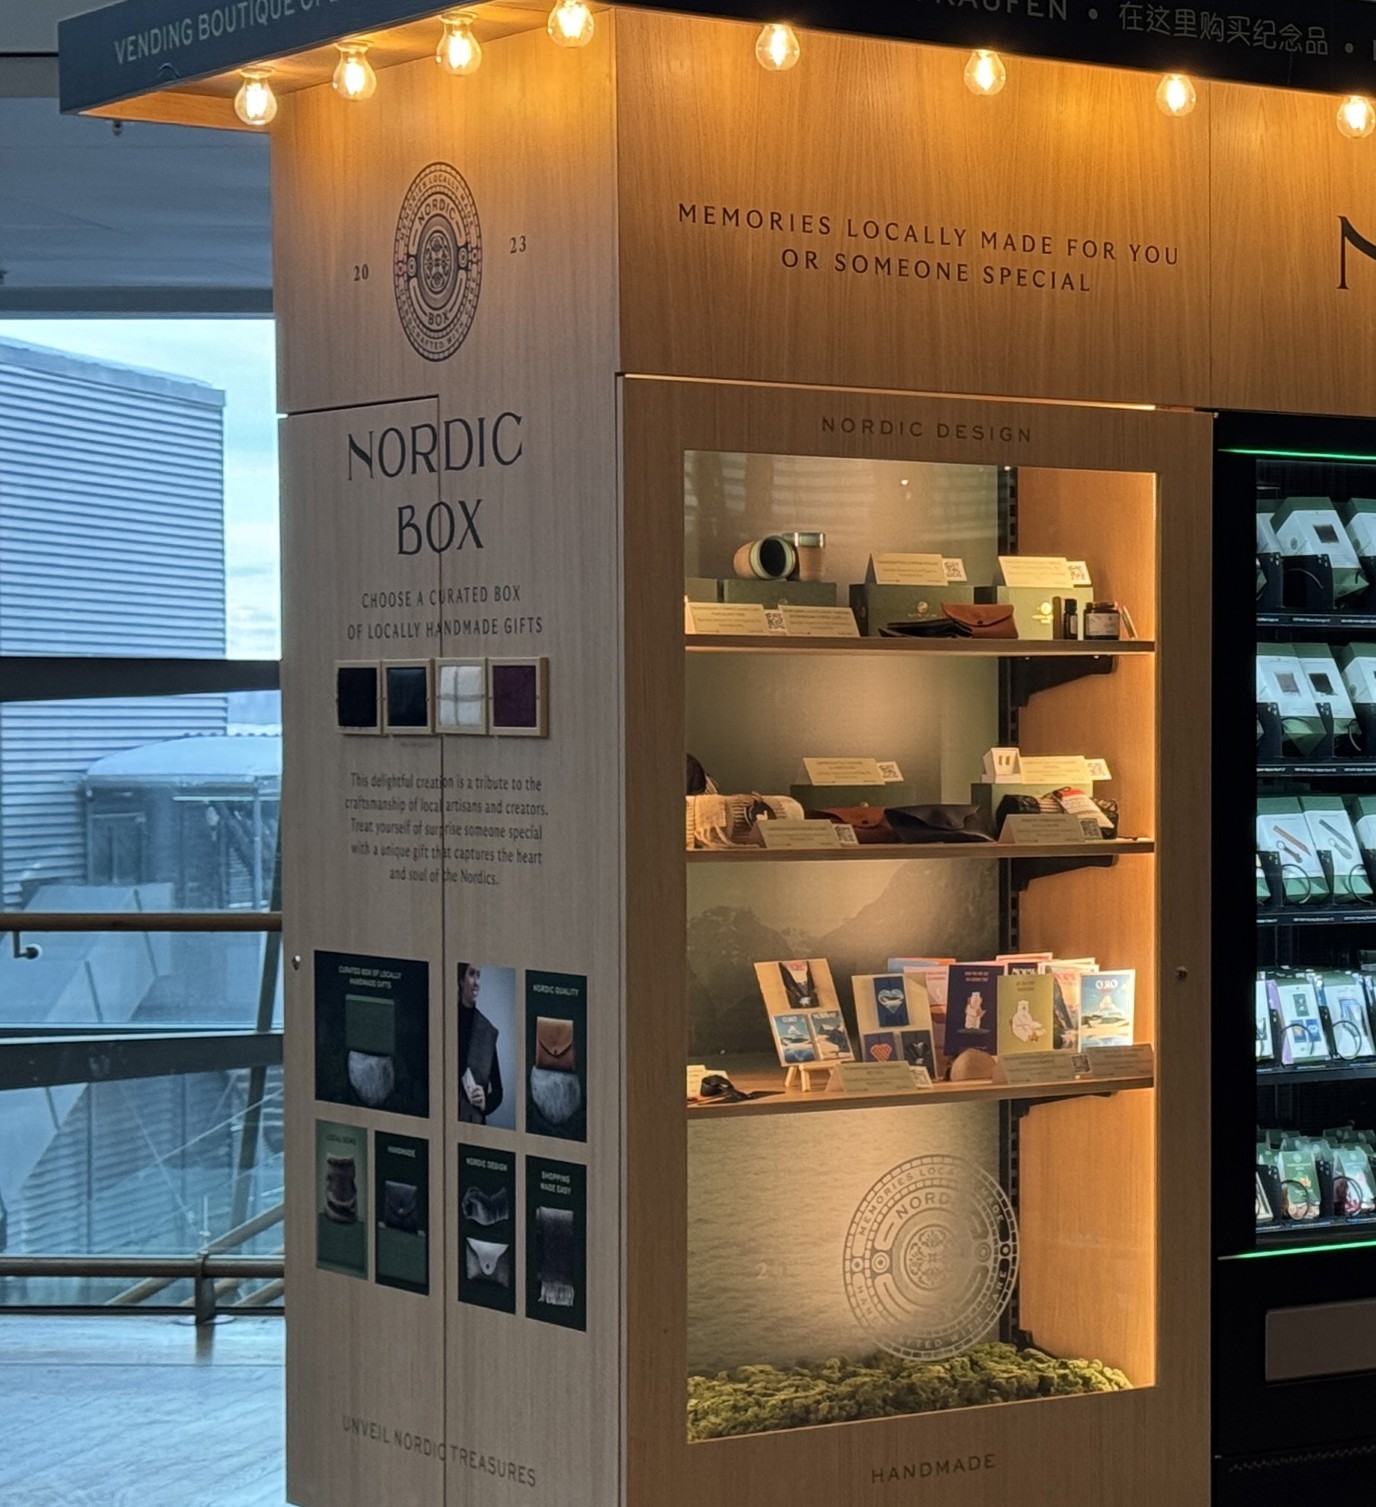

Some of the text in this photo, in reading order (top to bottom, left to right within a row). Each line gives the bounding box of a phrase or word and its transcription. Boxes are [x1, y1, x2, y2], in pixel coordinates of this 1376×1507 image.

[936, 0, 1067, 21] FEN
[114, 0, 296, 64] VENDING BOUTIQUE
[1119, 1, 1328, 55] 在这里购买纪念品
[417, 197, 456, 226] NORDIC
[510, 235, 527, 254] 23
[678, 203, 1180, 266] MEMORIES LOCALLY MADE FOR YOU
[354, 264, 369, 281] 20
[782, 248, 1091, 292] OR SOMEONE SPECIAL
[427, 310, 450, 327] BOX
[821, 416, 1031, 443] NORDIC DESIGN
[347, 411, 523, 481] NORDIC
[397, 499, 485, 555] BOX
[362, 585, 521, 609] CHOOSE A CURATED BOX
[347, 616, 543, 640] OF LOCALLY HANDMADE GIFTS
[351, 772, 369, 788] This
[370, 773, 413, 791] delightful
[416, 776, 454, 789] creation
[456, 776, 465, 789] is
[475, 776, 508, 791] tribute
[511, 777, 522, 791] to
[525, 776, 542, 791] the
[345, 796, 549, 817] craftsmanship of local artisans and creators.
[351, 818, 373, 834] Treat
[375, 820, 411, 836] yourself
[424, 822, 461, 839] surprise
[464, 825, 506, 838] someone
[508, 825, 542, 841] special
[351, 841, 371, 856] with
[381, 844, 410, 860] unique
[413, 843, 429, 861] gift
[431, 844, 451, 859] that
[454, 846, 495, 863] captures
[497, 847, 514, 862] the
[516, 848, 542, 864] heart
[389, 866, 499, 885] and soul of the Nordics.
[532, 983, 580, 997] NORDIC QUALITY
[541, 1170, 571, 1184] SHOPPING
[859, 1172, 914, 1237] MEMORIES
[980, 1186, 1004, 1223] MADE
[985, 1269, 1008, 1312] CARE
[342, 1414, 536, 1488] UNVEIL NORDIC TREASURES
[871, 1452, 997, 1485] HANDMADE
